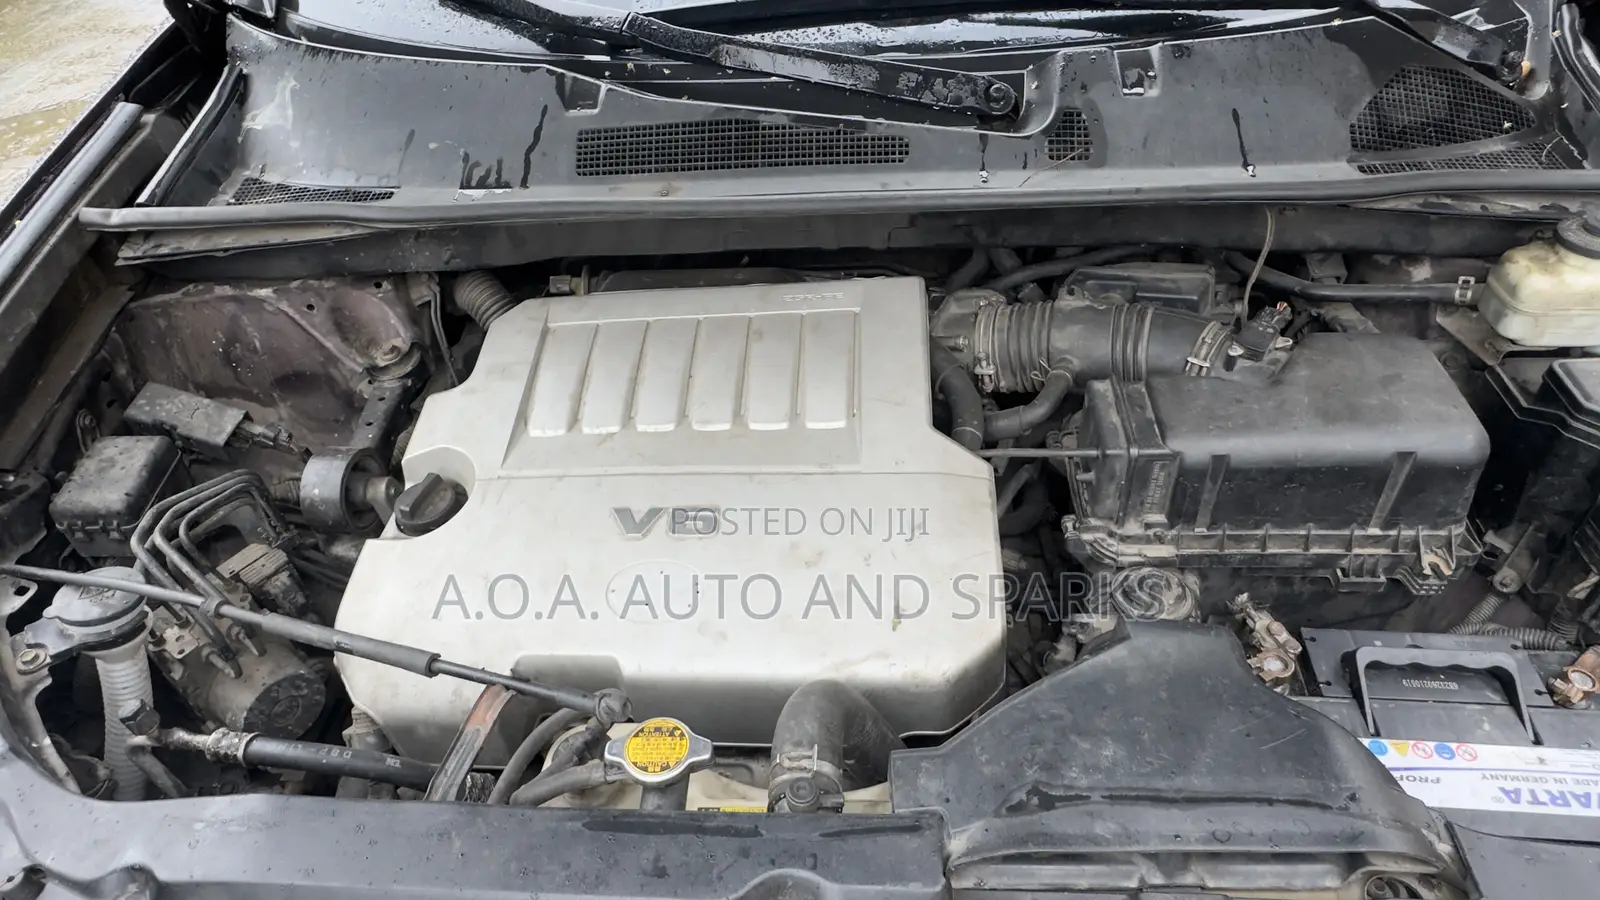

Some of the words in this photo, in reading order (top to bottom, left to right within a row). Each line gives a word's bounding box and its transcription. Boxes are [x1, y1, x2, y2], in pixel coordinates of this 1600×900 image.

[612, 506, 719, 538] V6
[1481, 772, 1549, 785] GERMANY
[1552, 777, 1569, 786] IN
[1570, 777, 1600, 787] ADE
